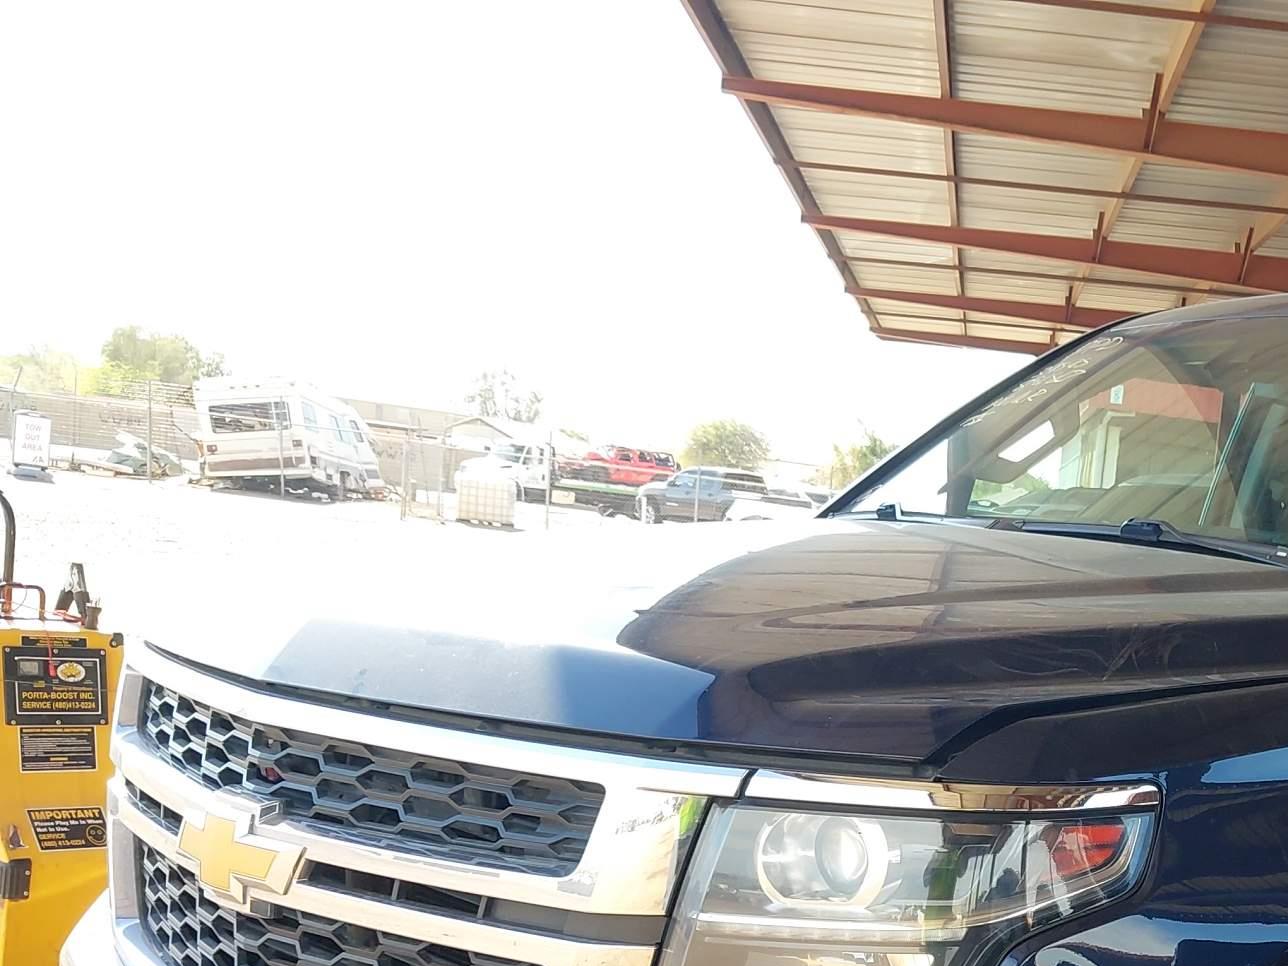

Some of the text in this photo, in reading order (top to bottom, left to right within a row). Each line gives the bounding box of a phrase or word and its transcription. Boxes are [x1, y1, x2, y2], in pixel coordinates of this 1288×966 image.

[22, 691, 78, 700] PORTA-BOOST
[22, 701, 51, 709] SERVICE
[30, 809, 100, 820] IMPORTANT
